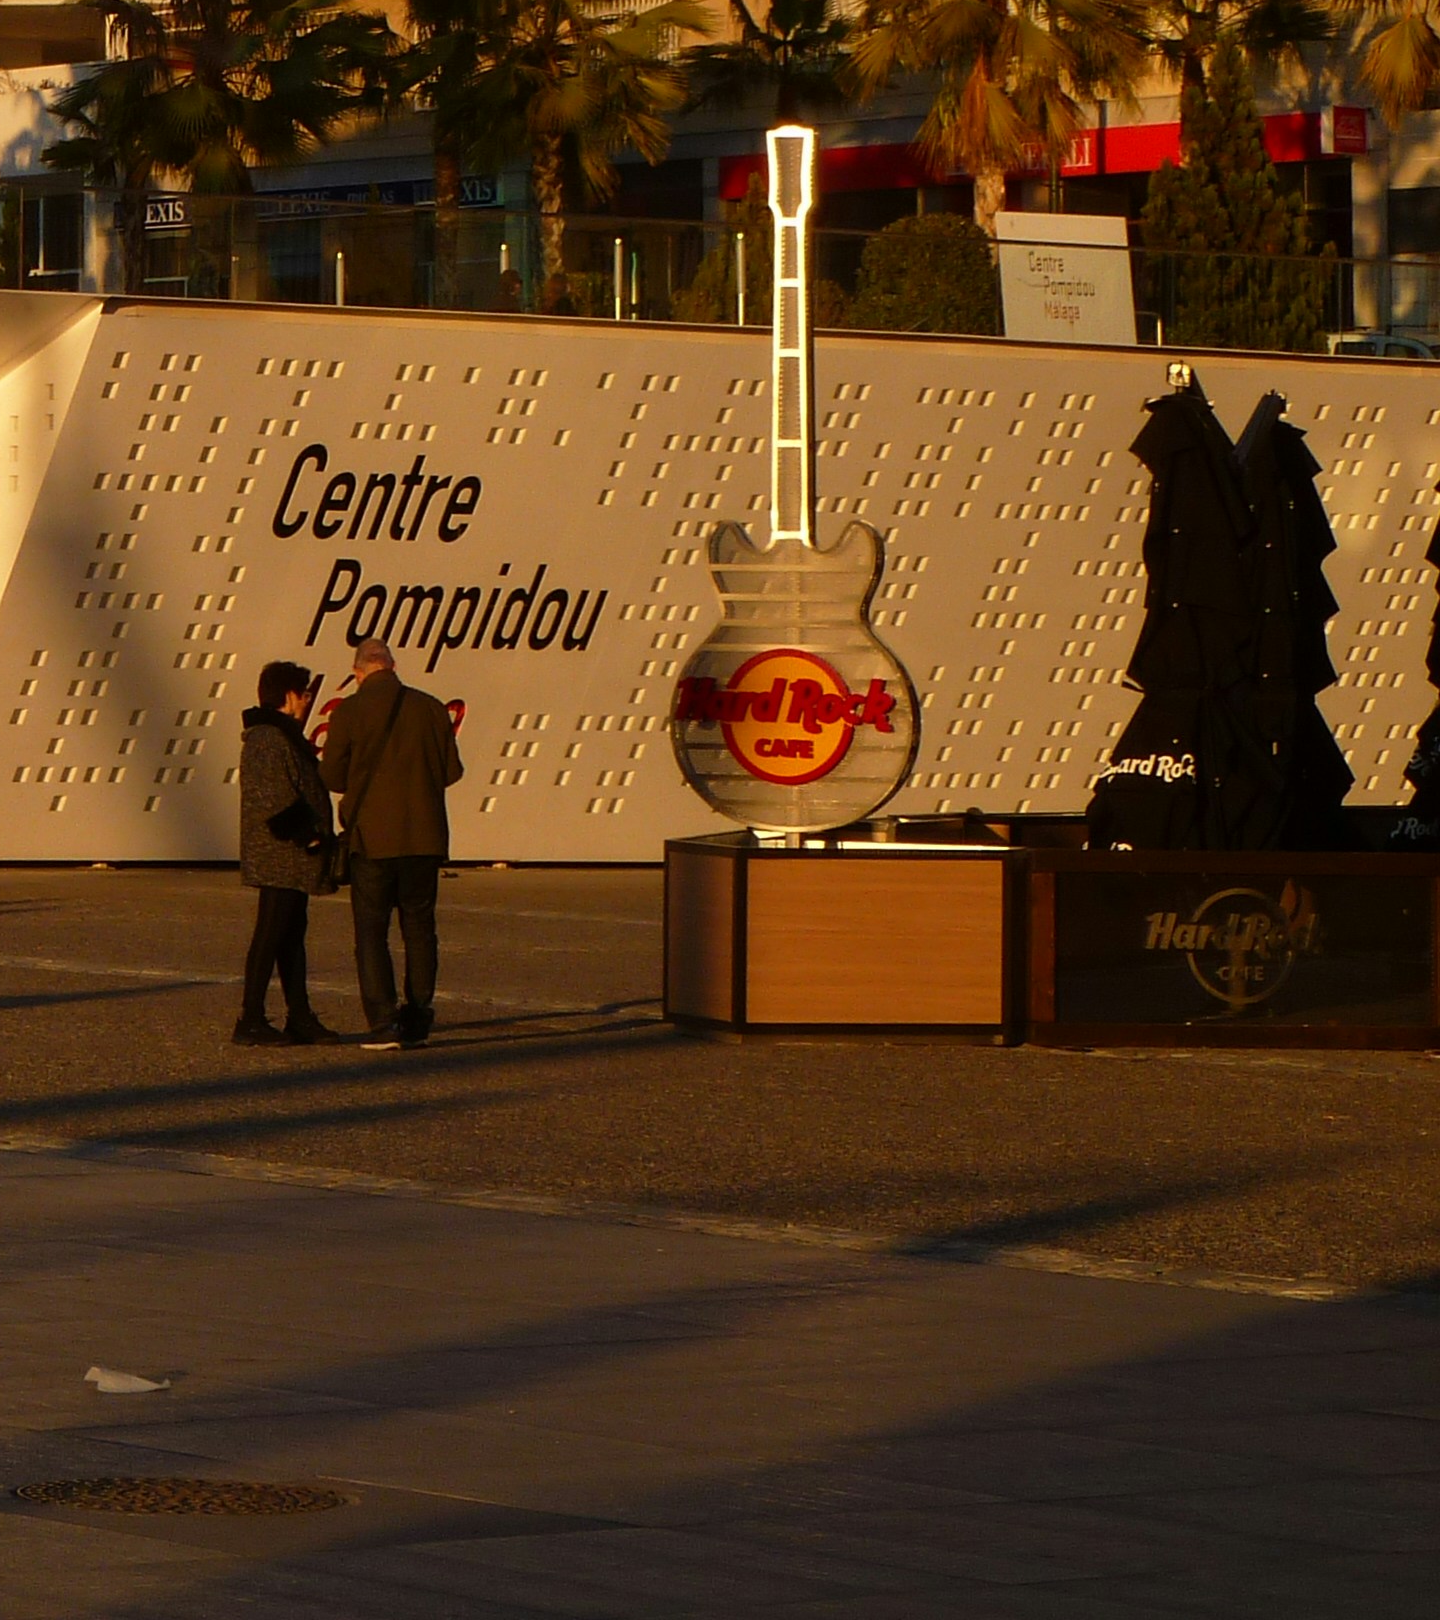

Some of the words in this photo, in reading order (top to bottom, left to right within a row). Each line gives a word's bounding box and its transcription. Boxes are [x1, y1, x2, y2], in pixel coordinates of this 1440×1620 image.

[144, 201, 185, 224] EXIS
[1028, 250, 1064, 272] Centre
[1044, 275, 1095, 298] Pompidou
[272, 443, 483, 543] Centre
[304, 558, 608, 673] Pompidou
[676, 676, 788, 723] Hard
[787, 678, 897, 734] Rock
[754, 738, 814, 759] CAFE
[1144, 912, 1241, 951] Hard
